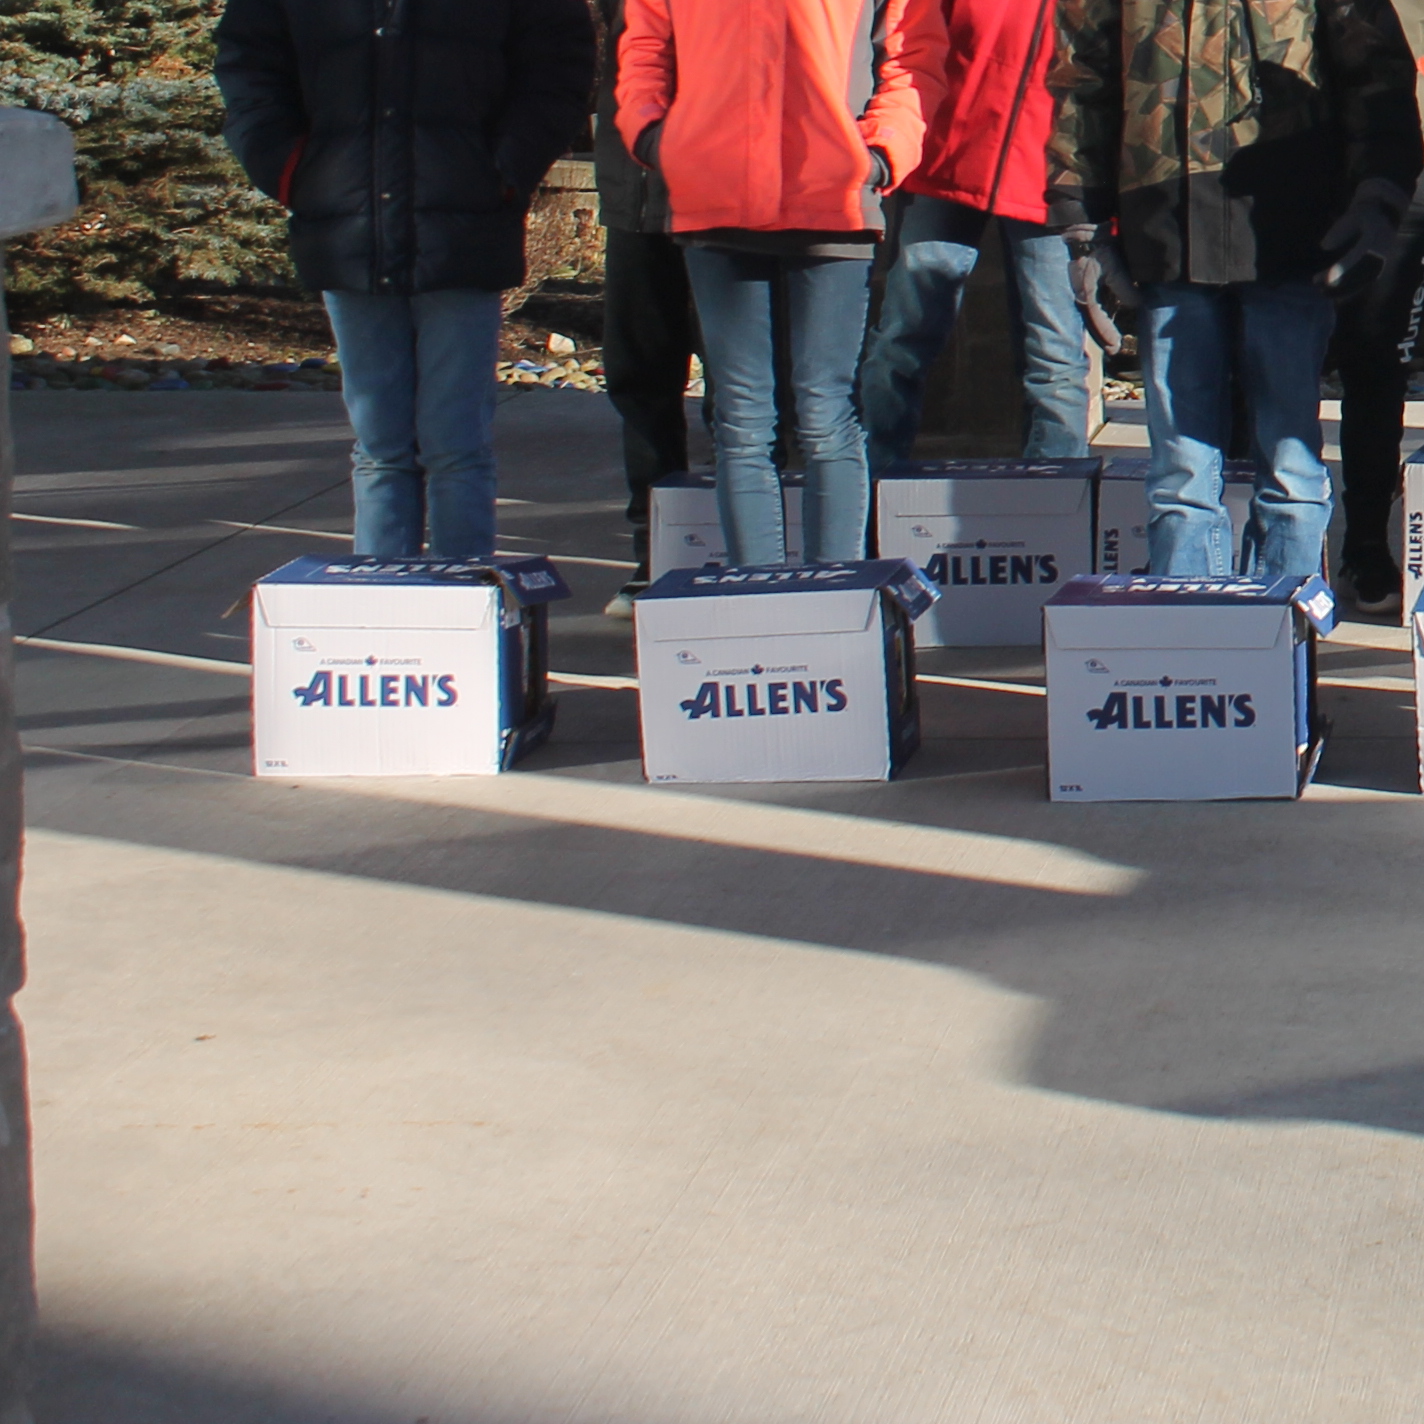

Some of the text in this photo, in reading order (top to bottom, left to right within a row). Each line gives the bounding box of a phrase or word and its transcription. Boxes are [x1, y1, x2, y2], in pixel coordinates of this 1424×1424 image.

[1408, 511, 1423, 579] ALLEN'S
[922, 553, 1059, 585] ALLEN'S
[292, 670, 459, 708] ALLEN'S
[678, 679, 848, 720] ALLEN'S
[1086, 691, 1256, 729] ALLEN'S
